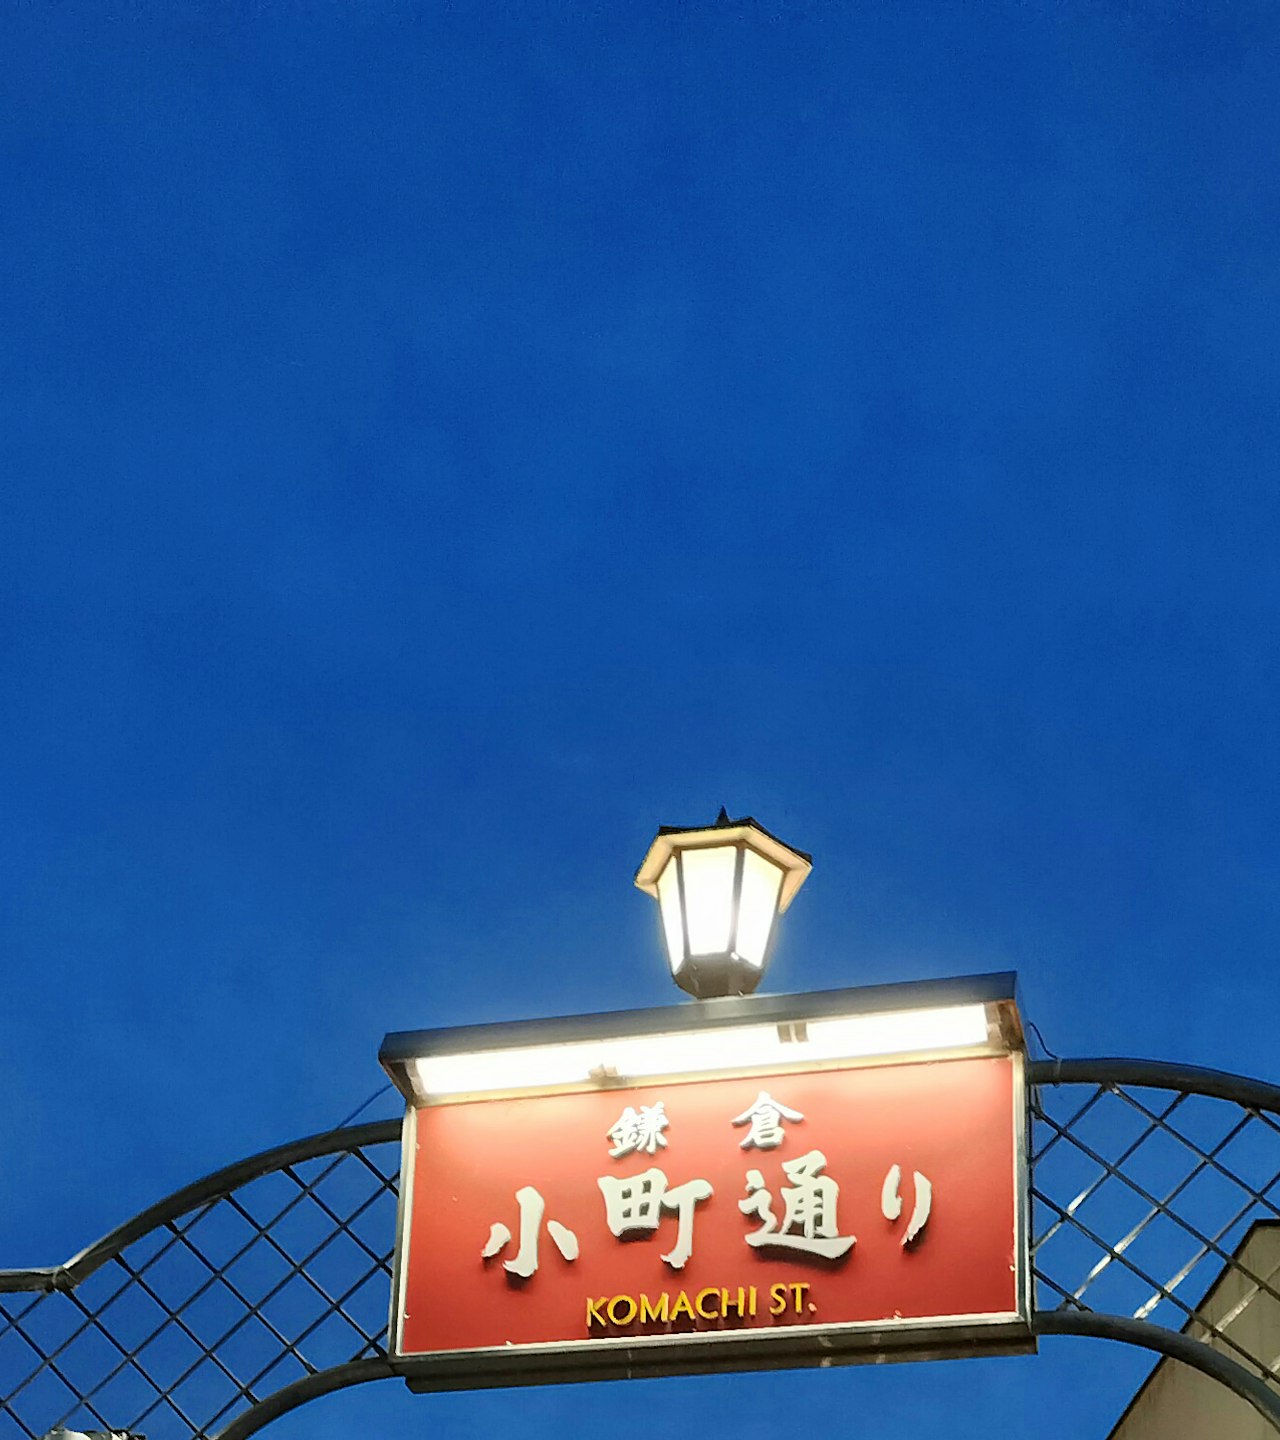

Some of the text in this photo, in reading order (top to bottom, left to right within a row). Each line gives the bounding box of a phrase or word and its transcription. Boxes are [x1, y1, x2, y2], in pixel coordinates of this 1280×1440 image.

[606, 1091, 804, 1158] 鎌倉
[481, 1150, 931, 1279] 小町通り
[586, 1282, 818, 1328] KOMACHI ST.
